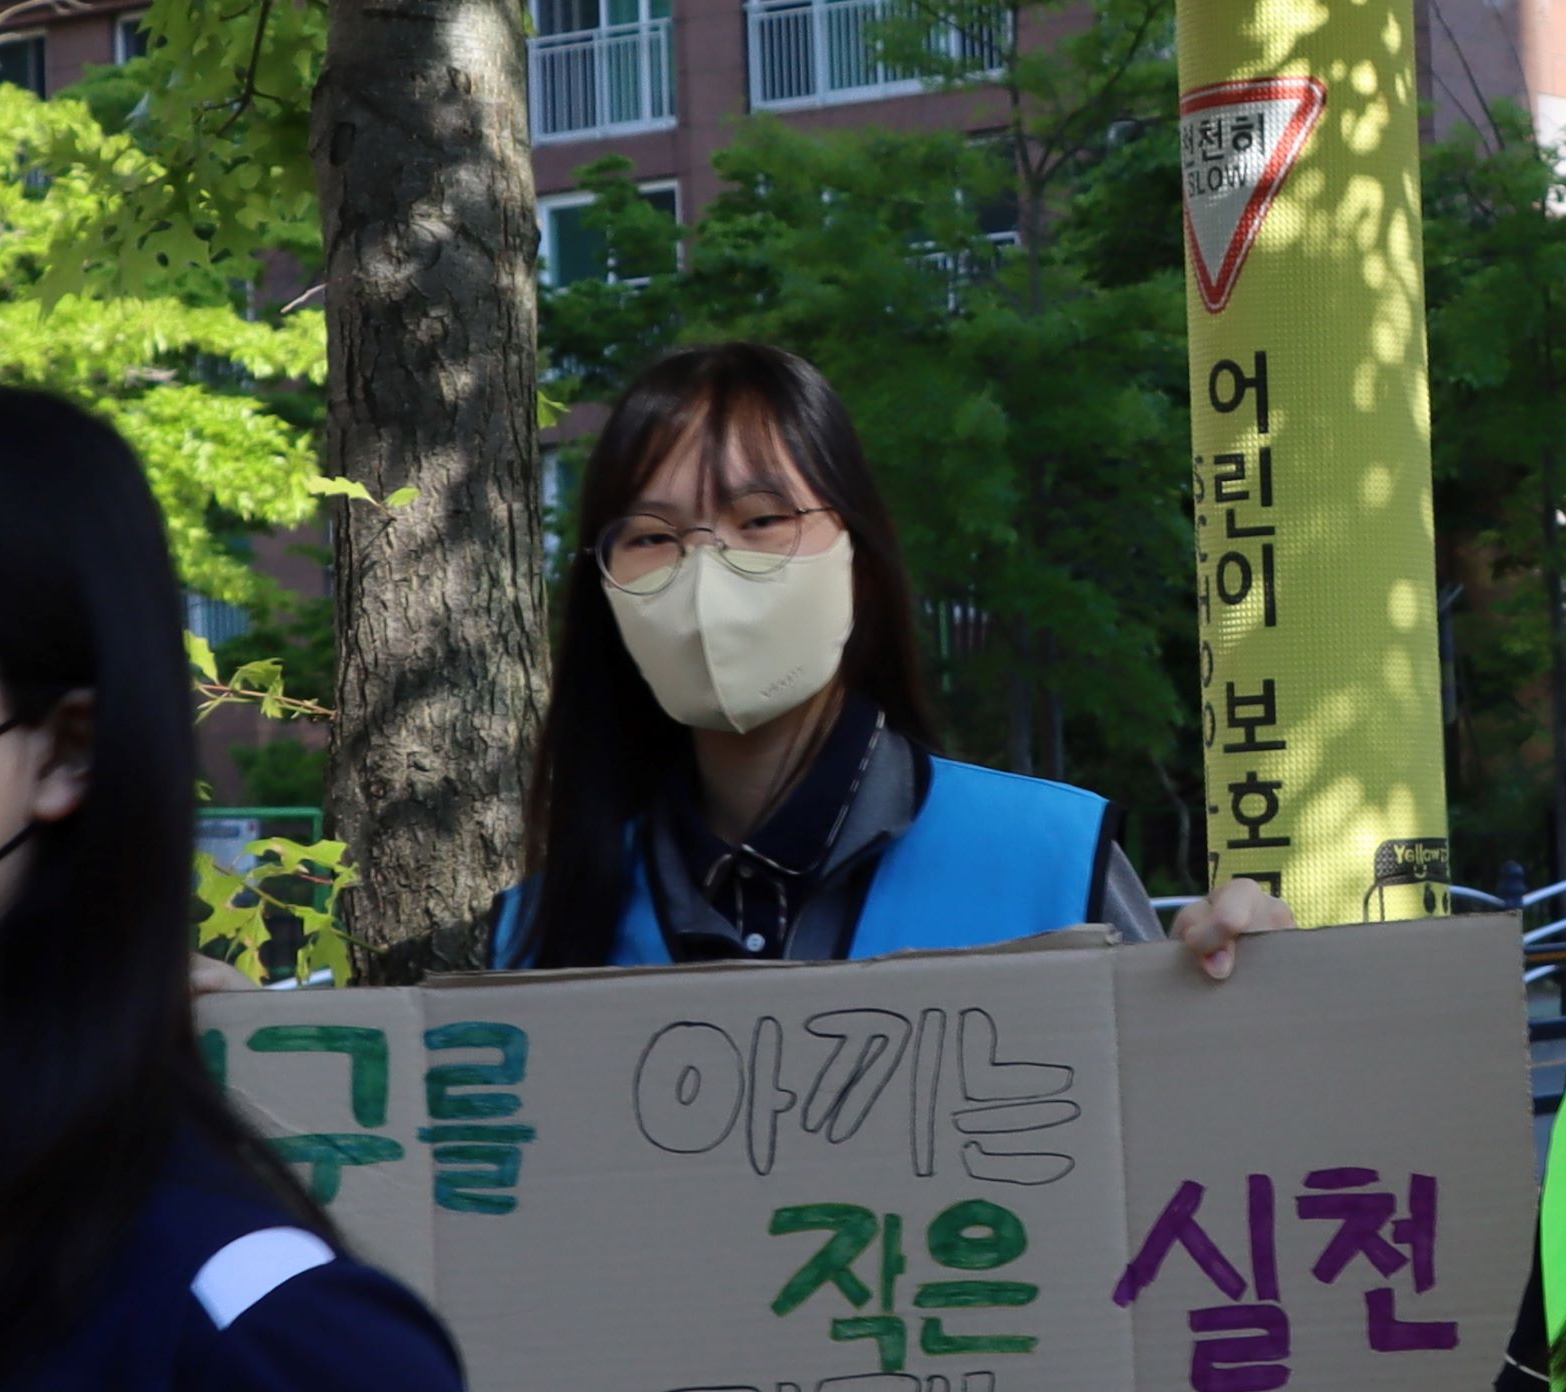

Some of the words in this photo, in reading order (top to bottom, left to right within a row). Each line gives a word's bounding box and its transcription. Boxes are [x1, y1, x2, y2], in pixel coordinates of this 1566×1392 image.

[1187, 163, 1248, 198] SLOW
[1209, 350, 1276, 627] 어린이
[200, 1020, 538, 1215] 구를
[633, 1007, 1082, 1186] 아끼는
[768, 1198, 1040, 1372] 작은
